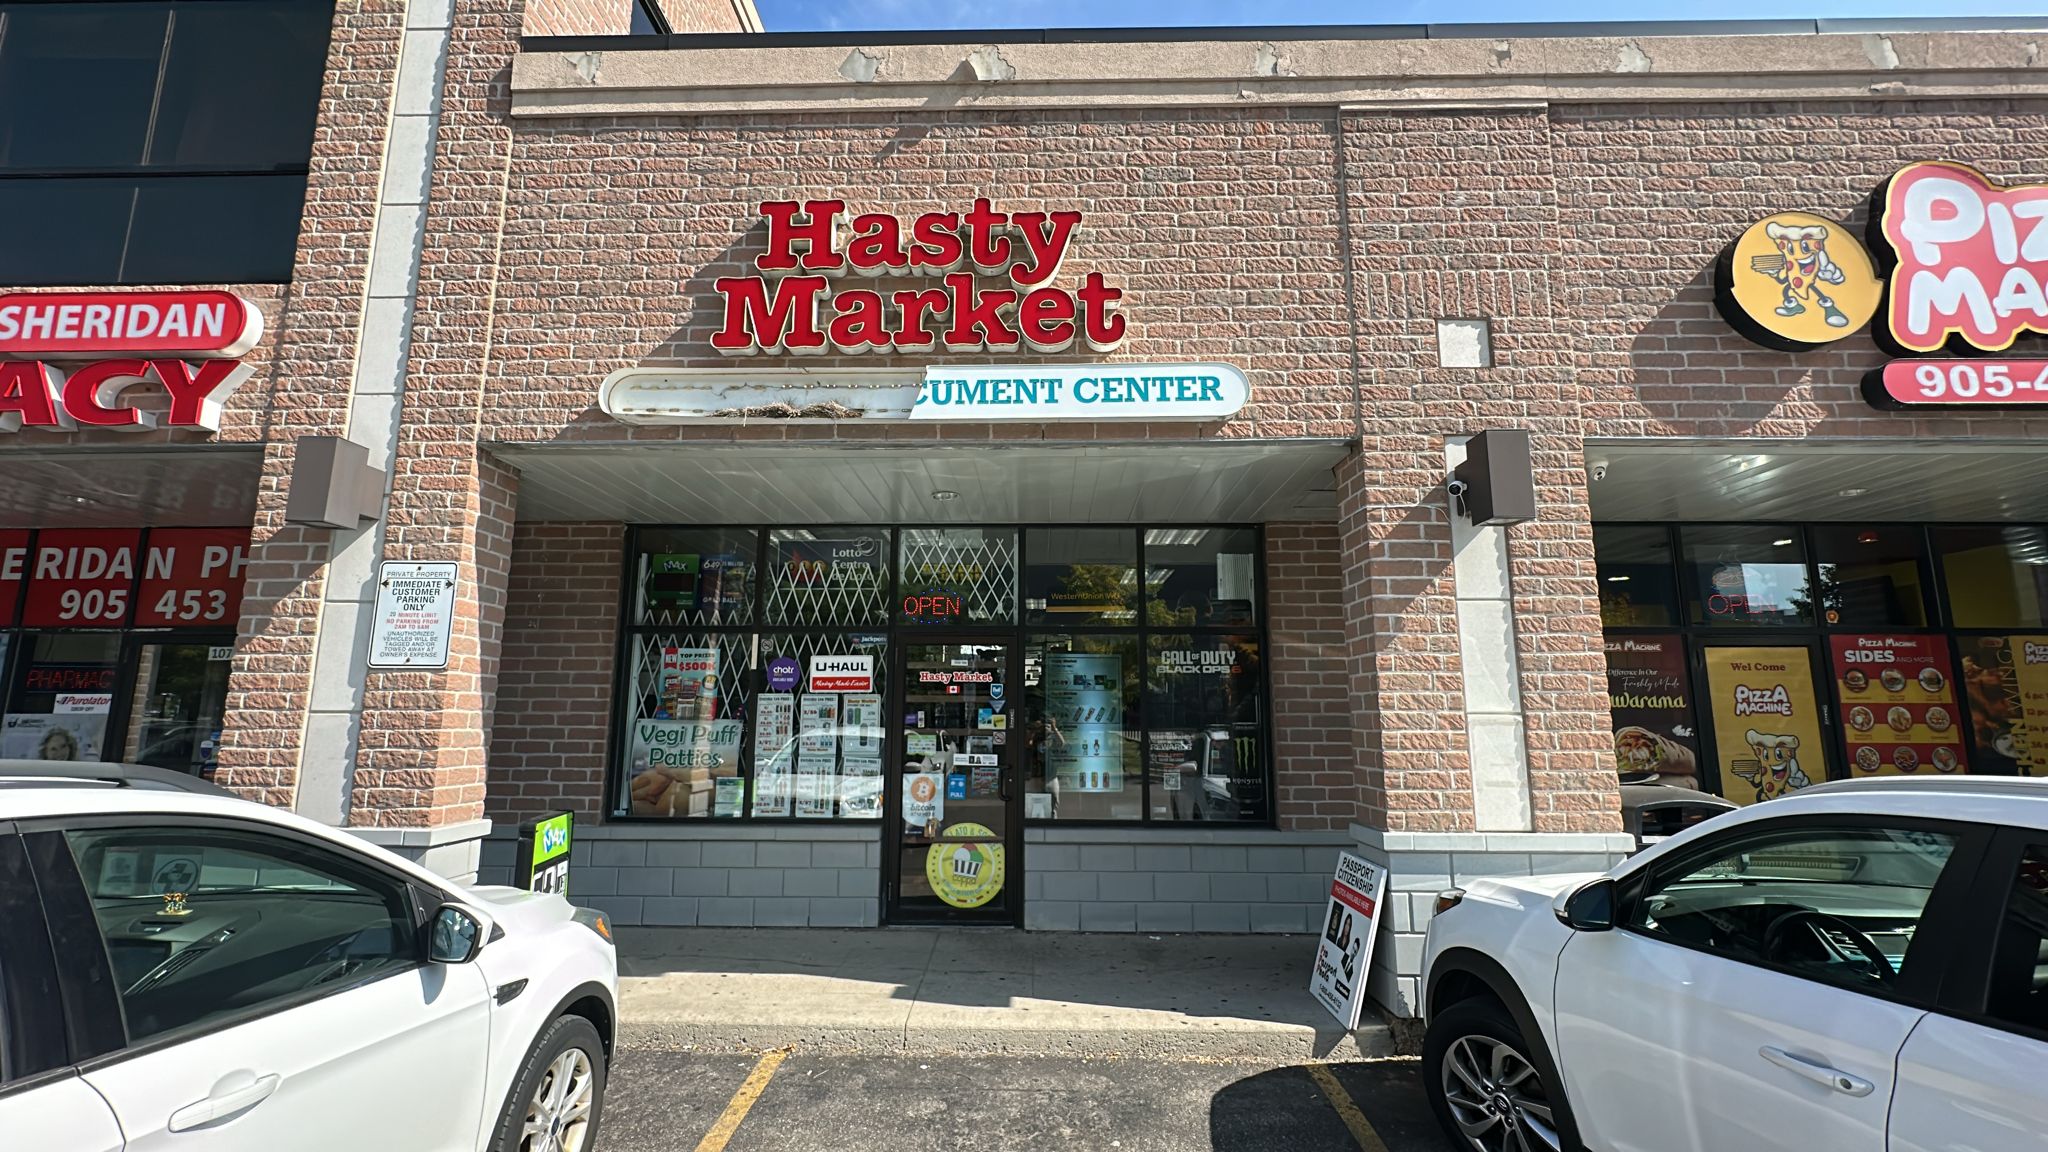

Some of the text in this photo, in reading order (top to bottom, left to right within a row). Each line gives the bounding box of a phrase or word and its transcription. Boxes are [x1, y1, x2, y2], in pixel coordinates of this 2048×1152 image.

[755, 198, 1082, 286] Hasty
[1908, 267, 2048, 335] MA
[710, 272, 1126, 348] Market
[0, 303, 225, 340] SHERIDAN
[1073, 376, 1224, 403] CENTER
[832, 548, 863, 558] Lotto
[392, 580, 442, 588] IMMEDIATE
[392, 588, 440, 596] CUSTOMER
[58, 589, 227, 620] 905 453
[904, 596, 961, 615] OPEN
[1161, 650, 1193, 665] CALL
[1200, 650, 1236, 665] DUTY
[1844, 649, 1896, 663] SIDES
[815, 662, 868, 672] U-HAUL
[1156, 665, 1242, 674] BLACK OPS 6
[1731, 662, 1786, 671] Wel Come
[815, 680, 835, 688] Moving
[920, 672, 993, 685] Hasty Market
[67, 696, 111, 705] Purolator
[640, 723, 738, 748] Vegi Puff
[650, 749, 722, 768] Patties
[910, 803, 936, 812] bitcoin
[1343, 857, 1375, 881] PASSPORT
[1337, 868, 1374, 895] CITIZENSHIP
